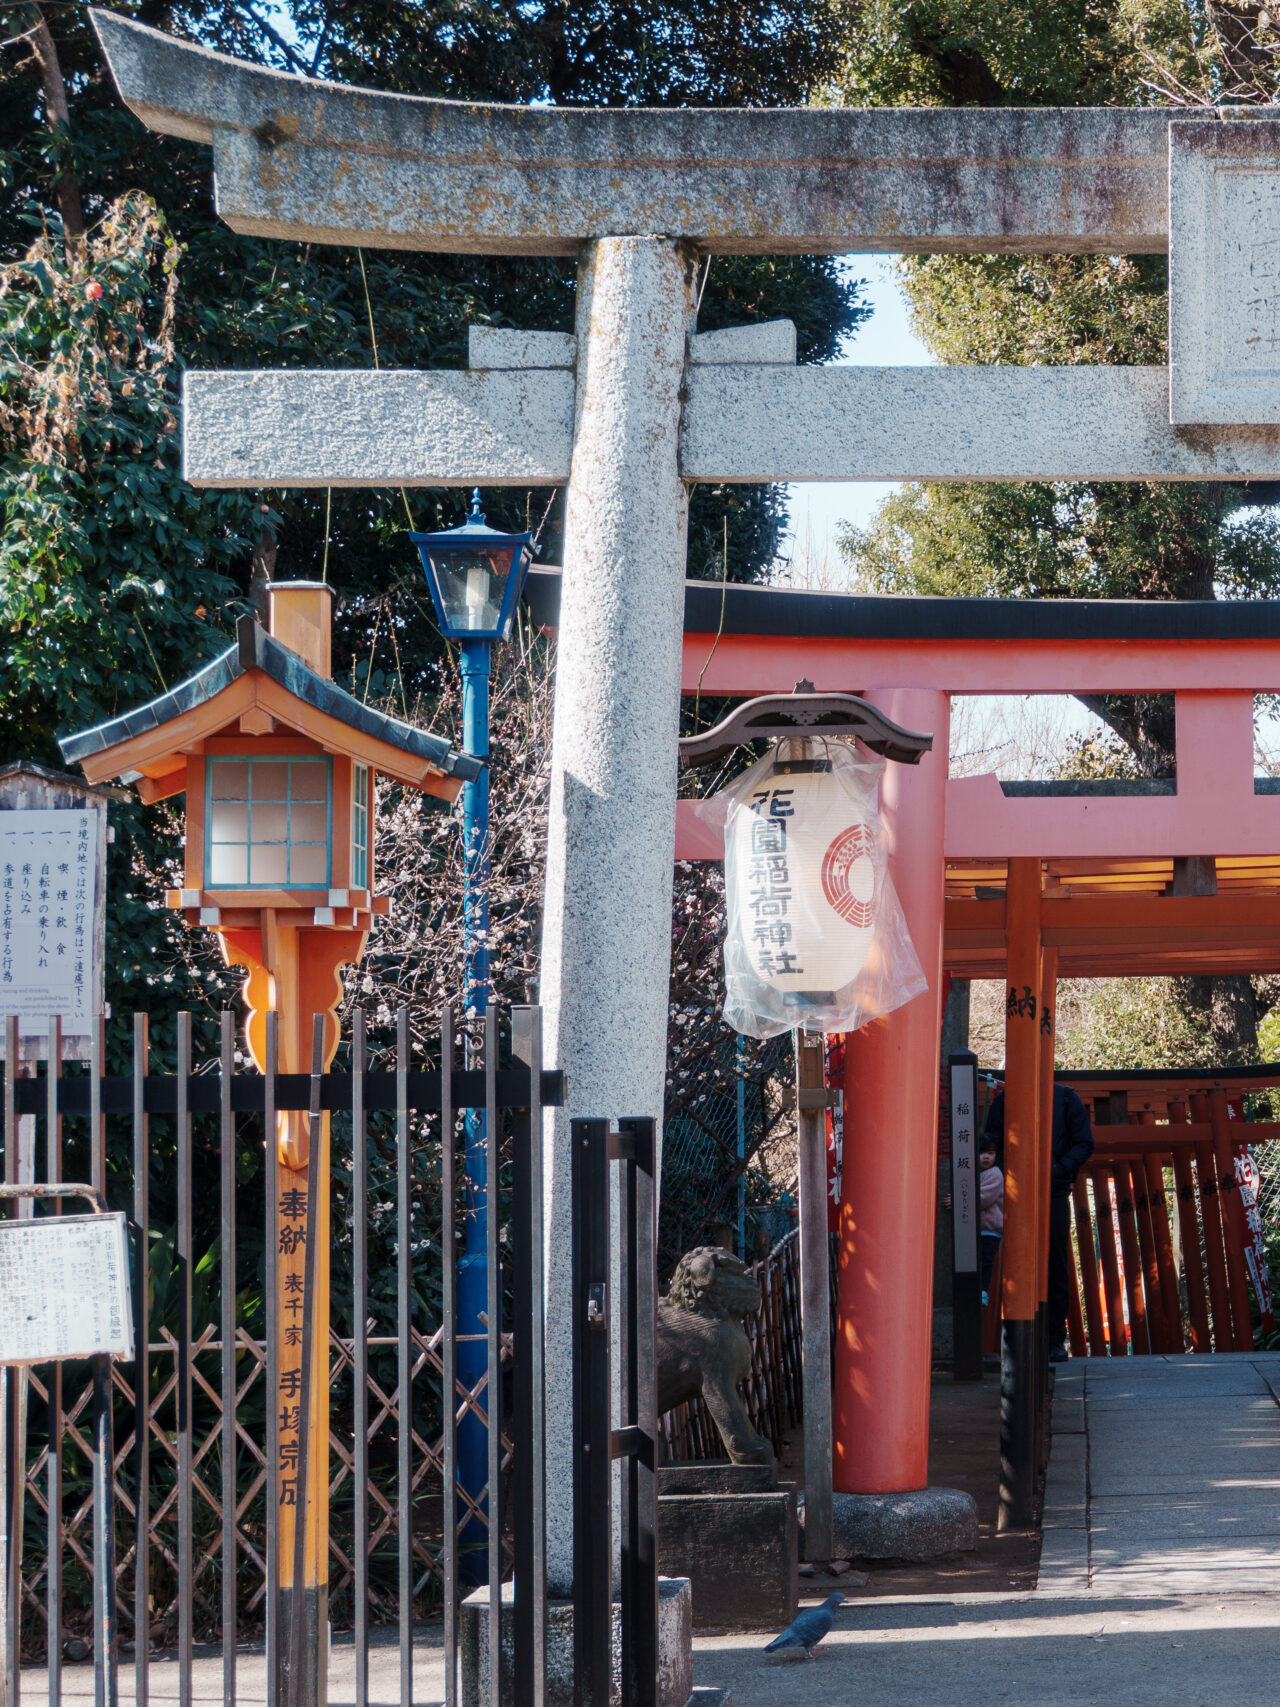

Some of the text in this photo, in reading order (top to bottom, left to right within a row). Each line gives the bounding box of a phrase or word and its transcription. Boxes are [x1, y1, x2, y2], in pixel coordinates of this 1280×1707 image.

[749, 789, 803, 977] 花園稲荷神社
[1007, 986, 1037, 1021] 納
[957, 1102, 970, 1169] 稲荷坂
[279, 1187, 308, 1255] 奉納
[284, 1272, 304, 1346] 表千家
